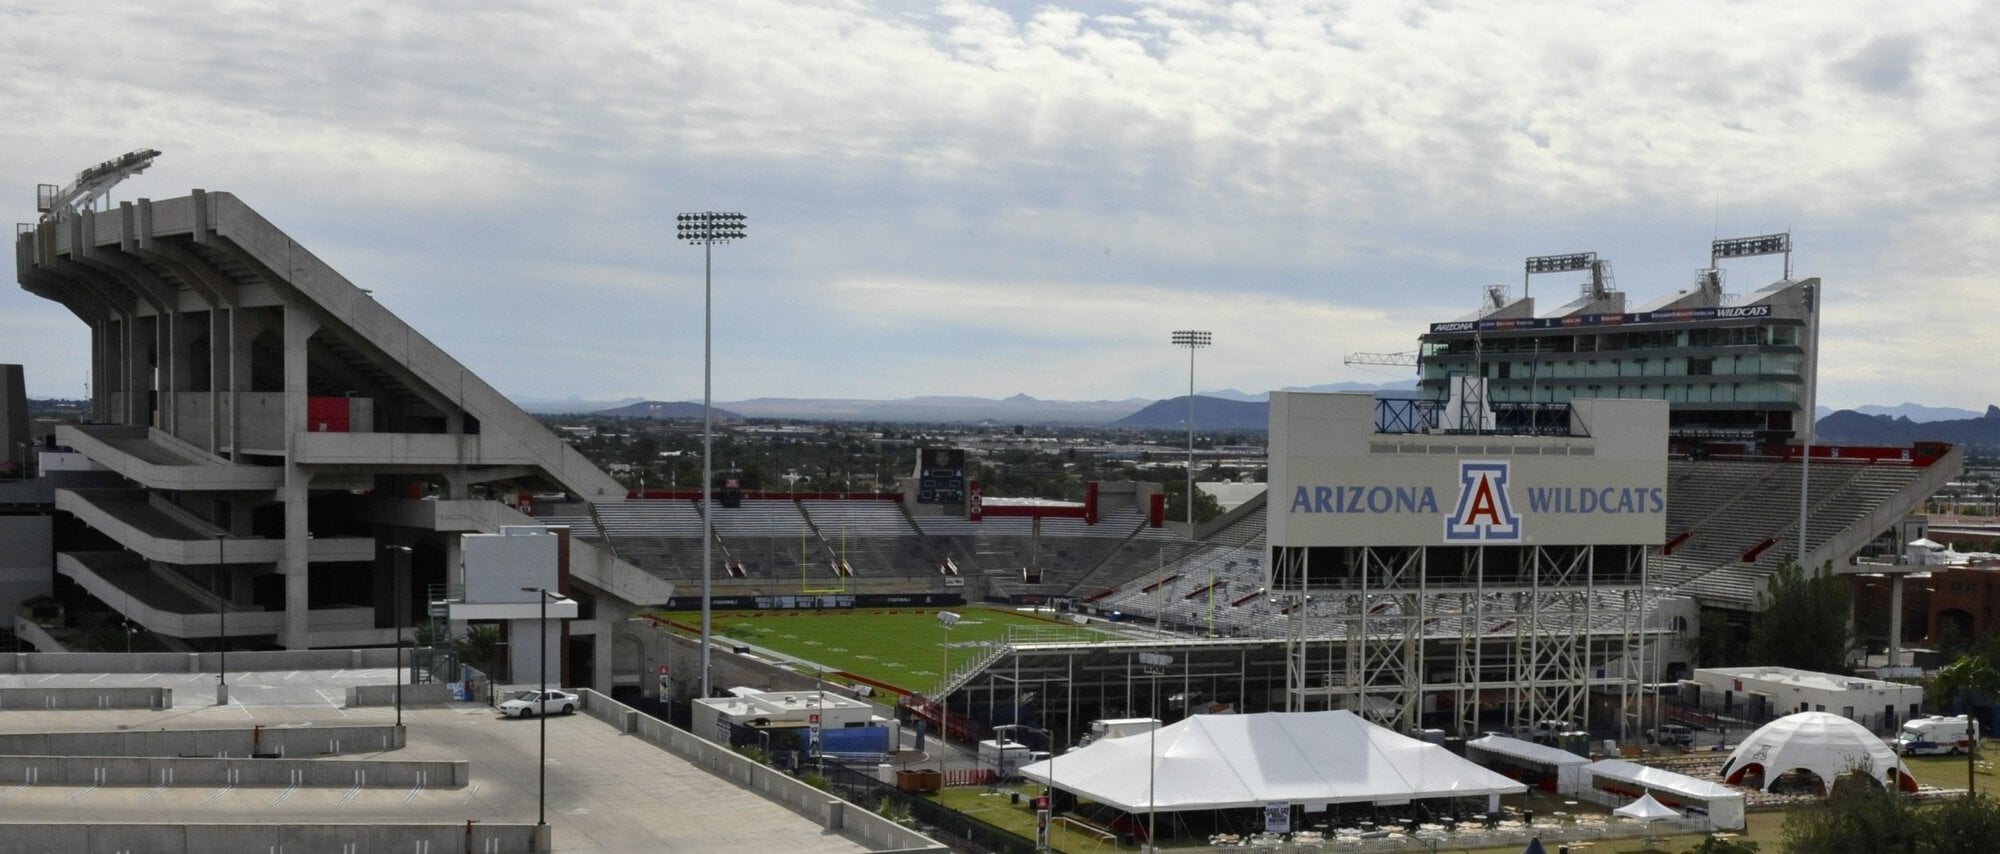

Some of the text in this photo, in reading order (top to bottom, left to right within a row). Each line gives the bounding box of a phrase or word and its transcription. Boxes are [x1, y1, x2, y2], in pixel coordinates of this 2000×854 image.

[1717, 306, 1768, 317] WILDCATS
[1434, 322, 1473, 332] ARIZONA
[1290, 459, 1665, 544] ARIZONA A WILDCATS
